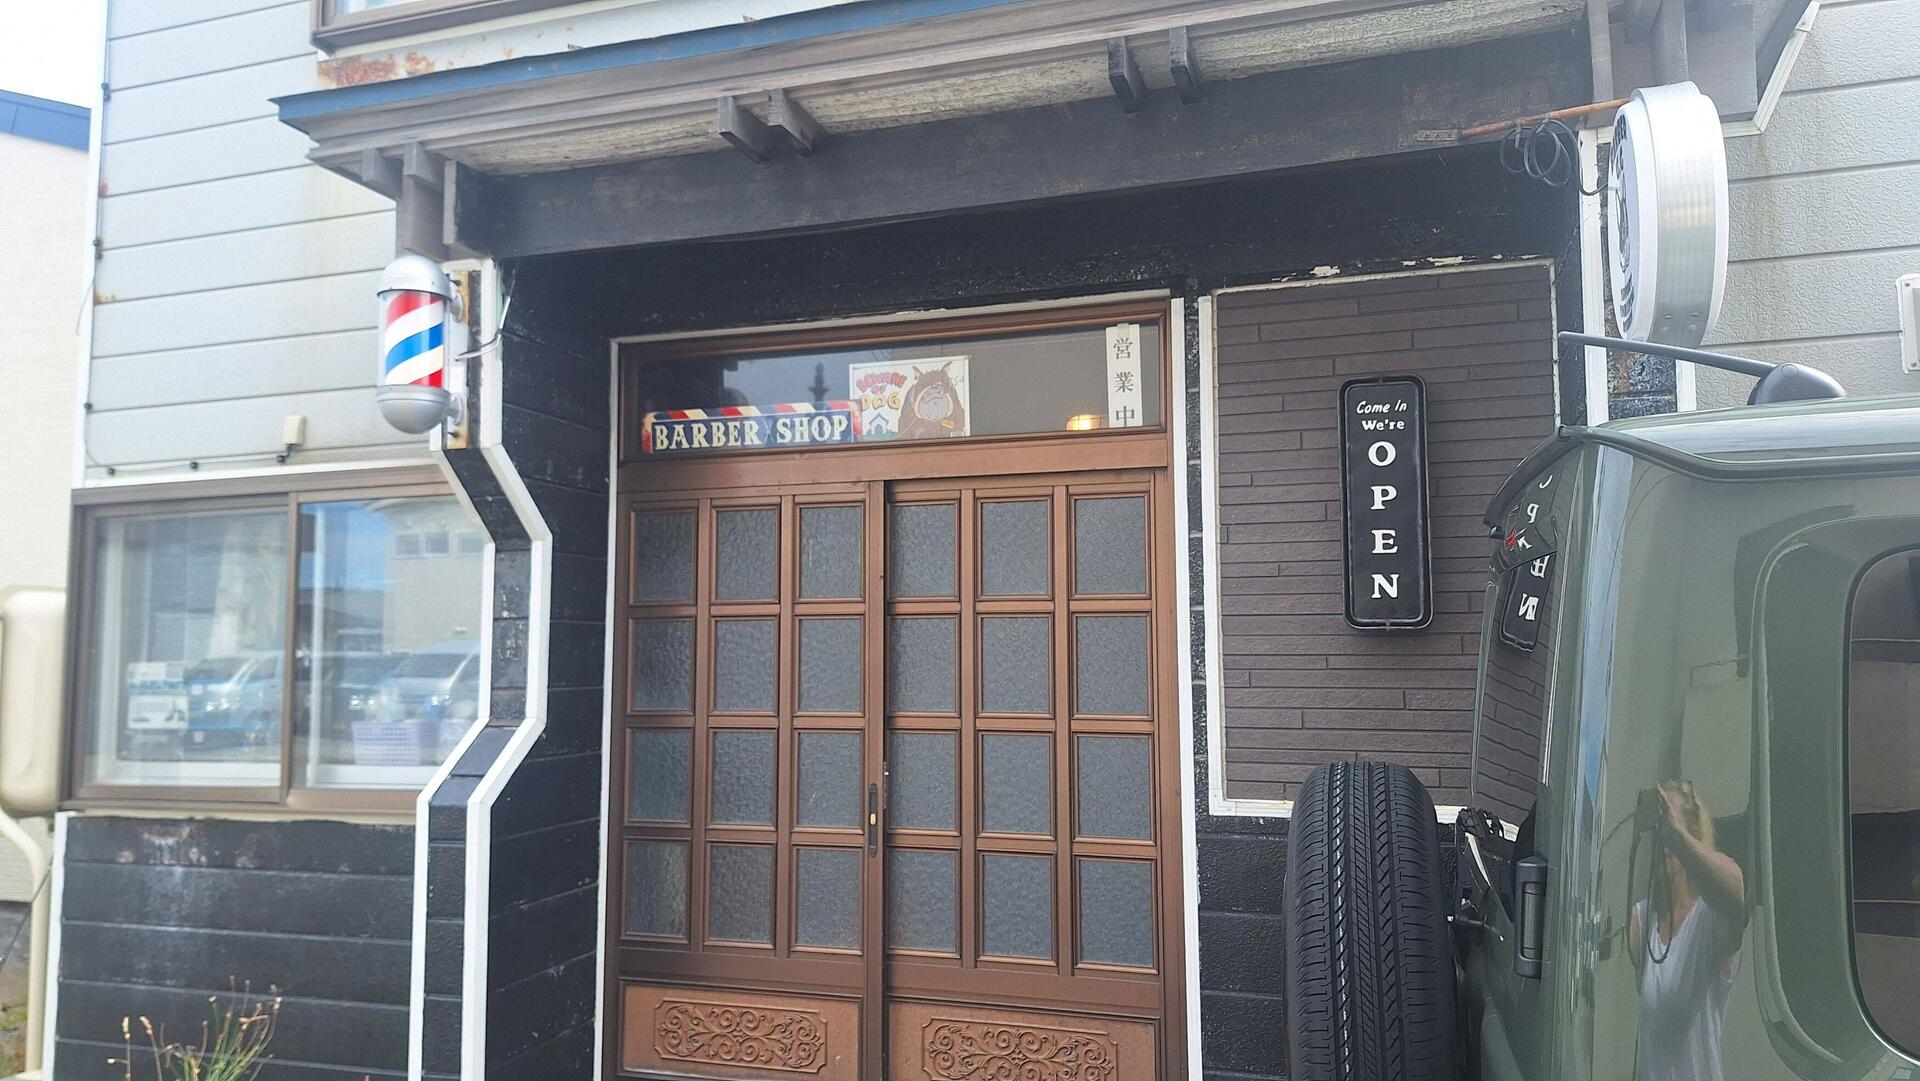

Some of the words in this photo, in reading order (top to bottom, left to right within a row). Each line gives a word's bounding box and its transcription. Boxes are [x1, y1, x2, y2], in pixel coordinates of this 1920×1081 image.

[1113, 337, 1135, 427] 営業中
[861, 391, 901, 412] DOG
[1356, 400, 1391, 414] Come
[1394, 399, 1408, 412] In
[654, 420, 762, 450] BARBER
[776, 415, 849, 443] SHOP
[1361, 418, 1405, 431] We're
[1368, 440, 1400, 599] OPEN
